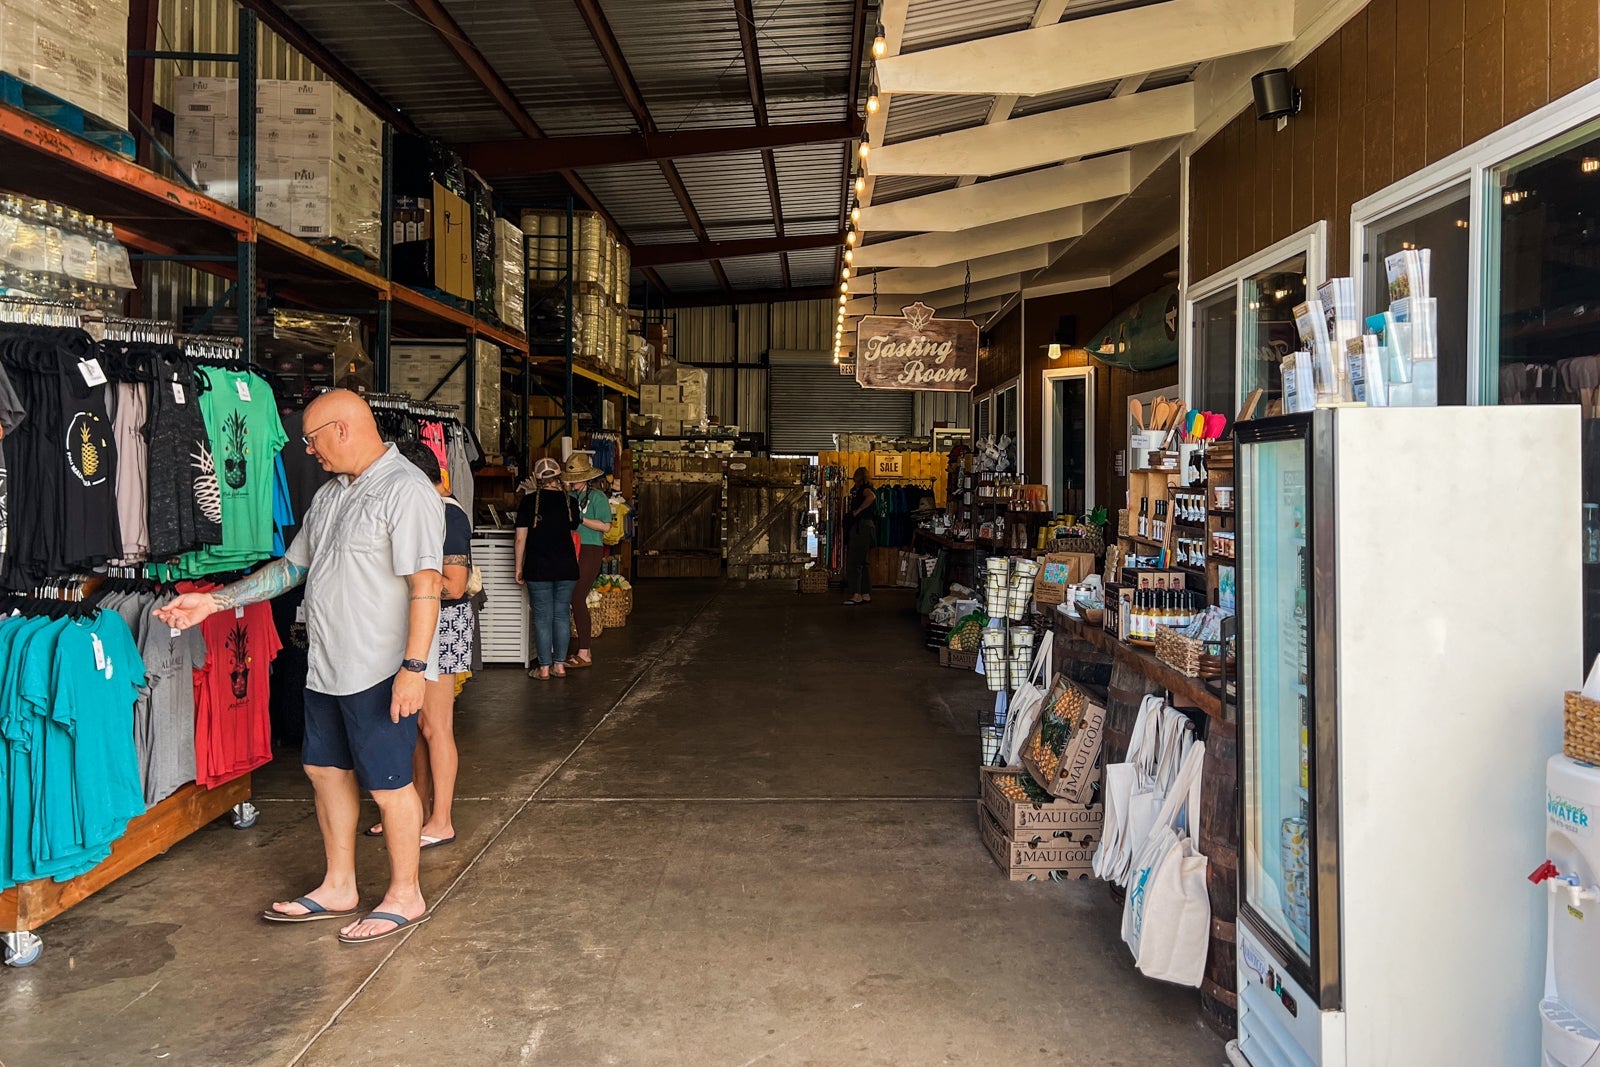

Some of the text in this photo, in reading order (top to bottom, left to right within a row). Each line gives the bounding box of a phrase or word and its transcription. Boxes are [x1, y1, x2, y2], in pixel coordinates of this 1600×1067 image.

[294, 169, 315, 180] PAU
[864, 335, 953, 364] Tasting
[897, 359, 968, 384] Room
[879, 462, 898, 472] SALE
[1067, 714, 1102, 787] MAUI GOLD
[1028, 811, 1103, 823] MAUI GOLD
[1548, 801, 1588, 827] WATER
[1023, 850, 1062, 862] MAUI
